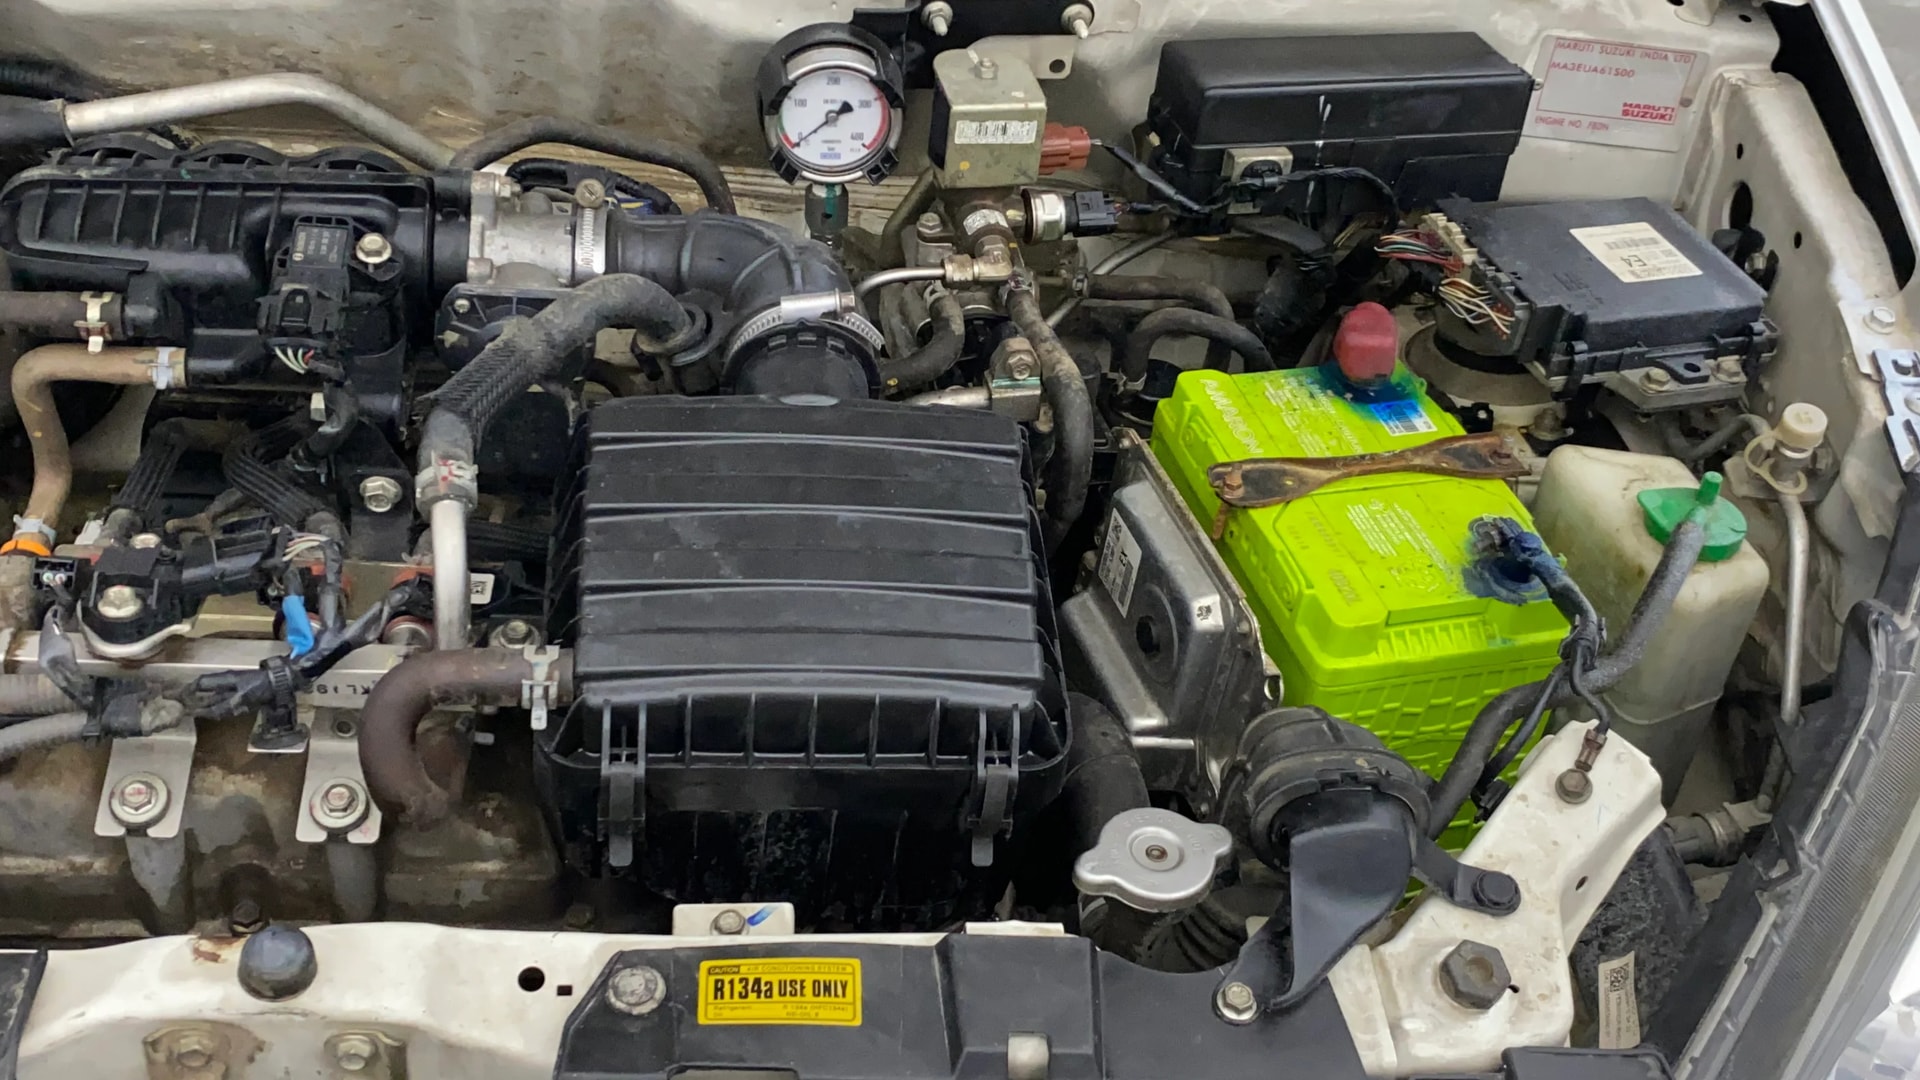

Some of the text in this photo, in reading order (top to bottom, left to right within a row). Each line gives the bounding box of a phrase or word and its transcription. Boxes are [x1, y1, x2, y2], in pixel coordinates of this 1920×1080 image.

[1557, 41, 1692, 64] MARUTI SUZUKI INDIA LTD
[826, 76, 841, 85] 200
[794, 98, 808, 107] 100
[858, 100, 872, 108] 300
[1622, 102, 1675, 113] MARUTI
[1622, 109, 1673, 122] SUZUKI
[850, 132, 864, 141] 400
[1200, 378, 1265, 455] AMARON
[710, 966, 740, 974] CAUTION
[713, 977, 848, 1000] R134a USE ONLY
